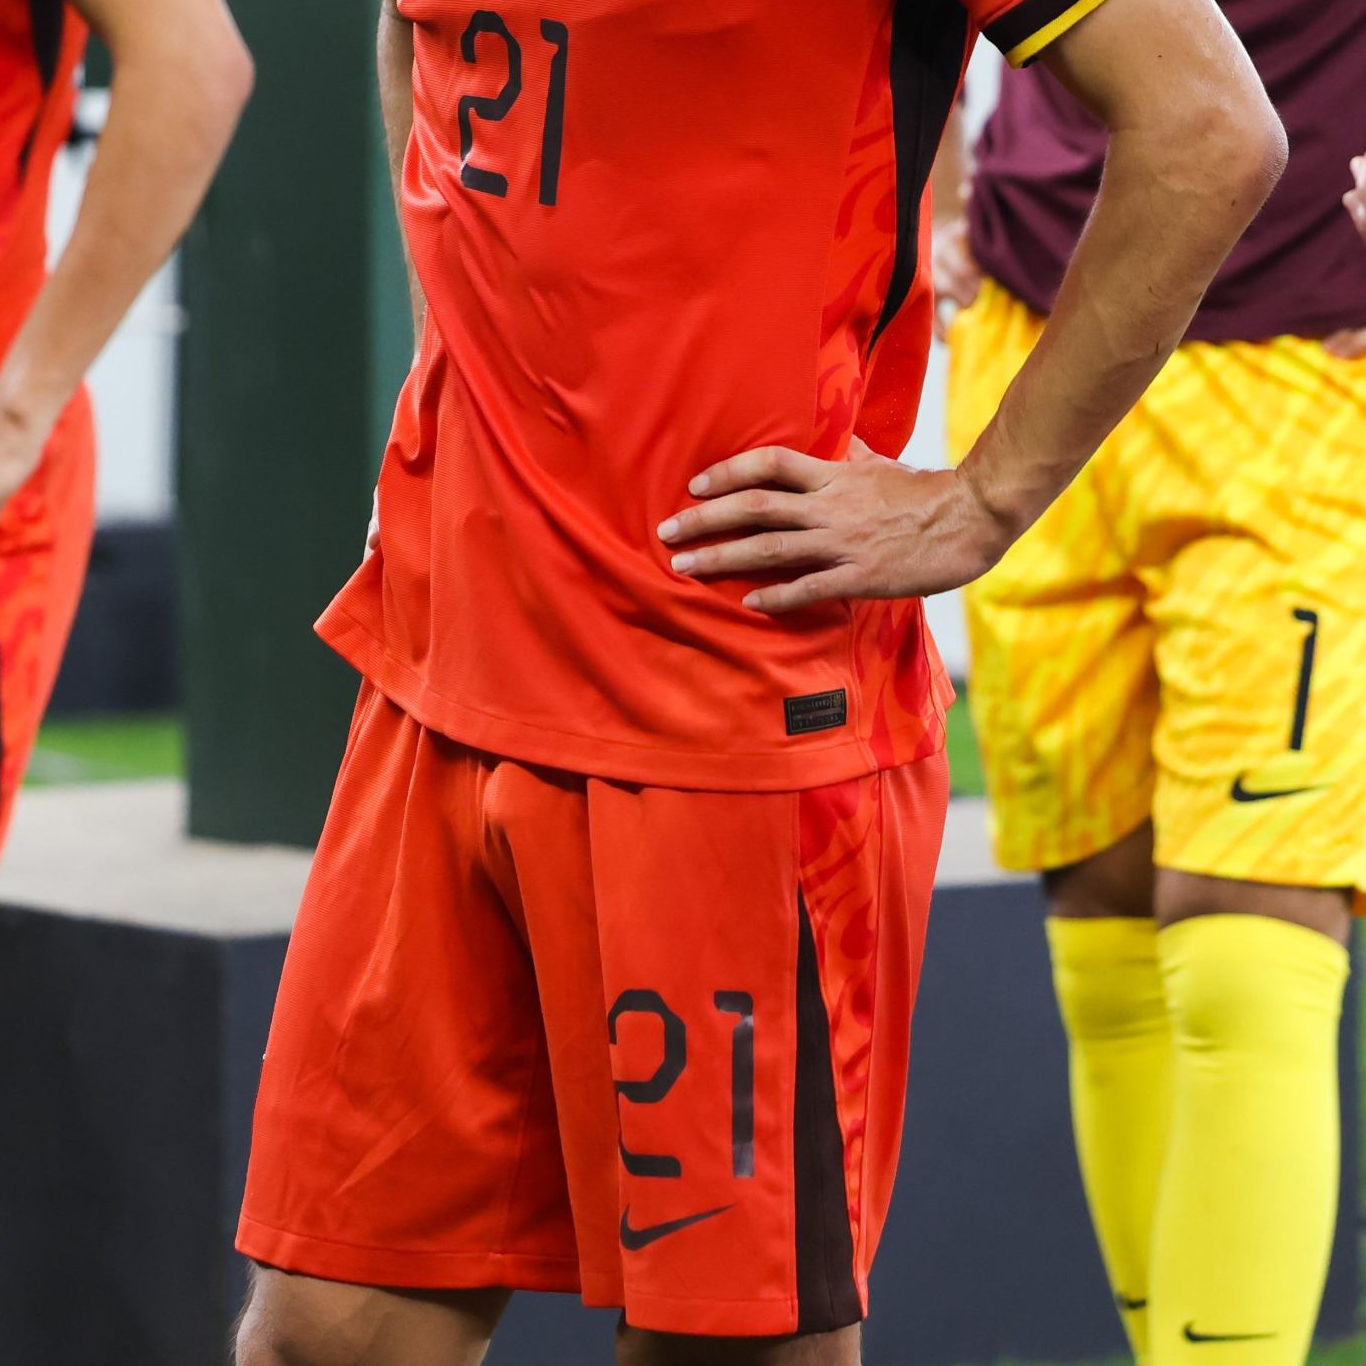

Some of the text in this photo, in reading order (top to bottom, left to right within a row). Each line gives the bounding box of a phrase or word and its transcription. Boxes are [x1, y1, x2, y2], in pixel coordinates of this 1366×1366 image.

[458, 9, 569, 207] 21
[1290, 606, 1318, 752] 1
[608, 988, 754, 1179] 21
